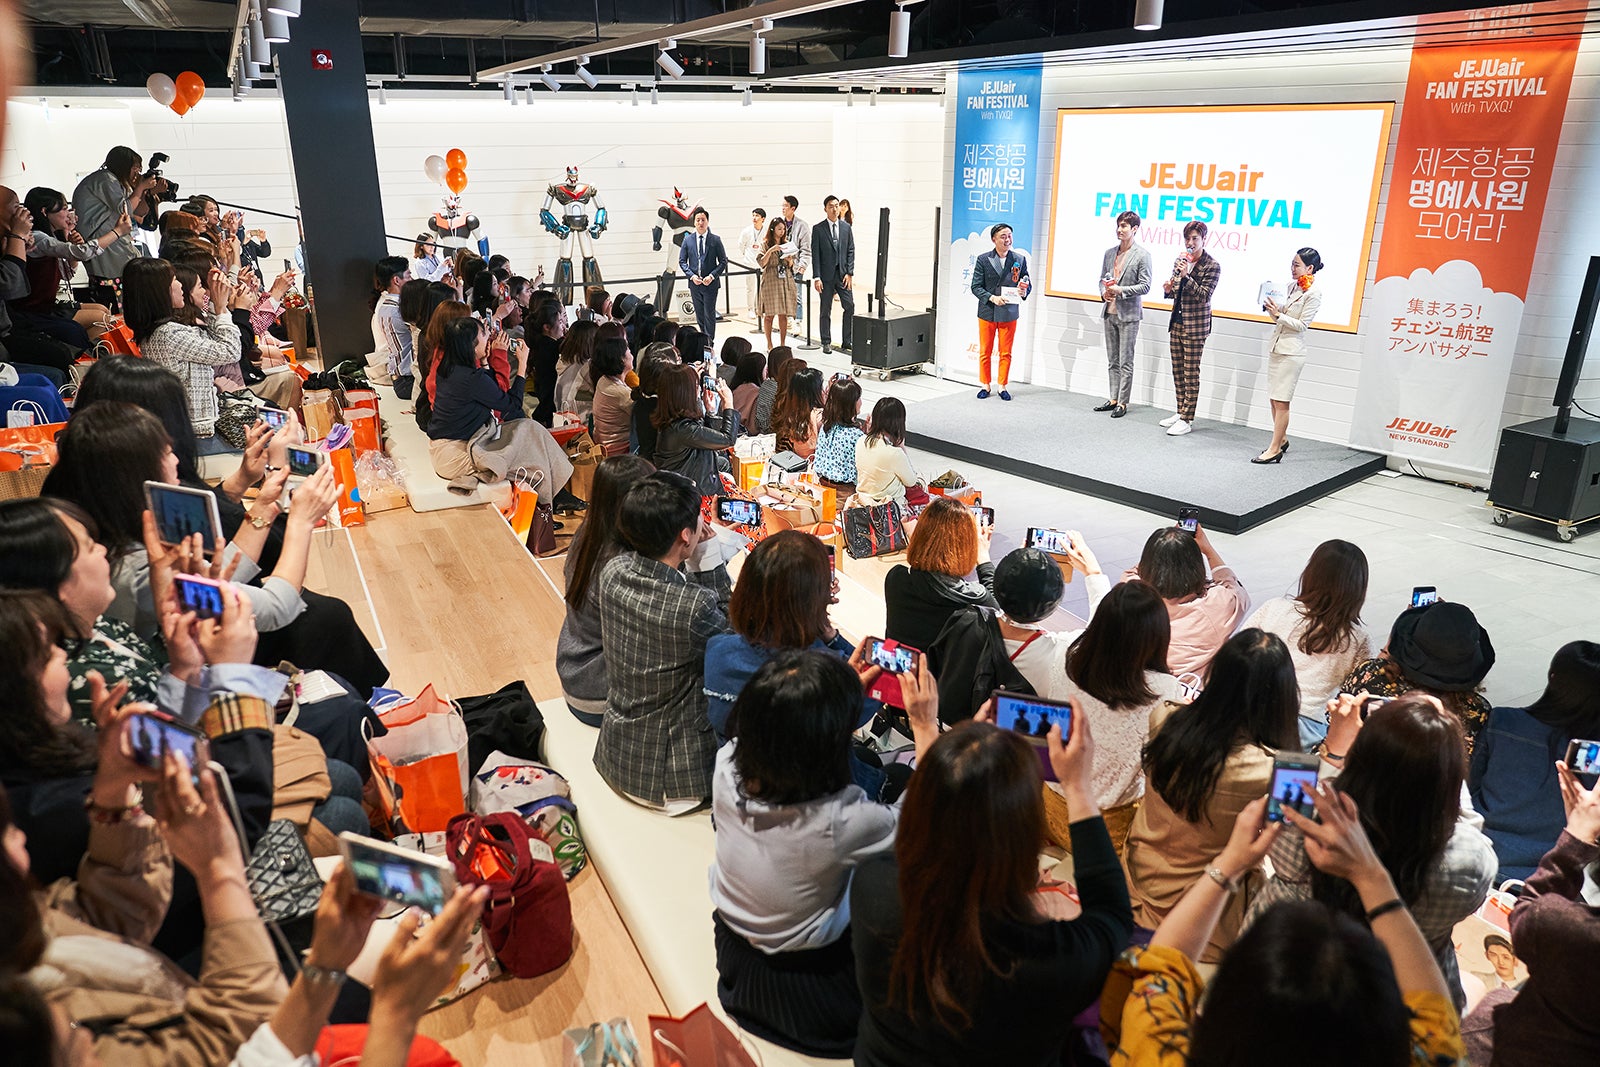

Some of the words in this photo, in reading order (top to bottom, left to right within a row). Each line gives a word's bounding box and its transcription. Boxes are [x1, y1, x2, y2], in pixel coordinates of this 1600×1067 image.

[1453, 57, 1525, 79] JEJUair
[980, 80, 1016, 94] JEJUair
[1425, 81, 1459, 99] FAN
[1461, 77, 1547, 98] FESTIVAL
[967, 96, 984, 109] FAN
[986, 94, 1029, 109] FESTIVAL
[1450, 102, 1475, 114] With
[1479, 100, 1513, 113] TVXQ!
[963, 143, 1026, 166] 제주항공
[1411, 147, 1535, 178] 제주항공
[963, 167, 1024, 190] 명예사원
[1139, 162, 1264, 192] JEJUair
[968, 190, 1016, 213] 모여라
[1408, 179, 1528, 211] 명예사원
[1095, 192, 1149, 219] FAN
[1158, 195, 1312, 229] FESTIVAL
[1140, 226, 1180, 246] With
[1415, 211, 1507, 243] 모여라
[1388, 337, 1488, 360] アンバサダー
[1386, 417, 1457, 439] JEJUair
[1389, 433, 1406, 441] NEW
[1407, 436, 1449, 449] STANDARD
